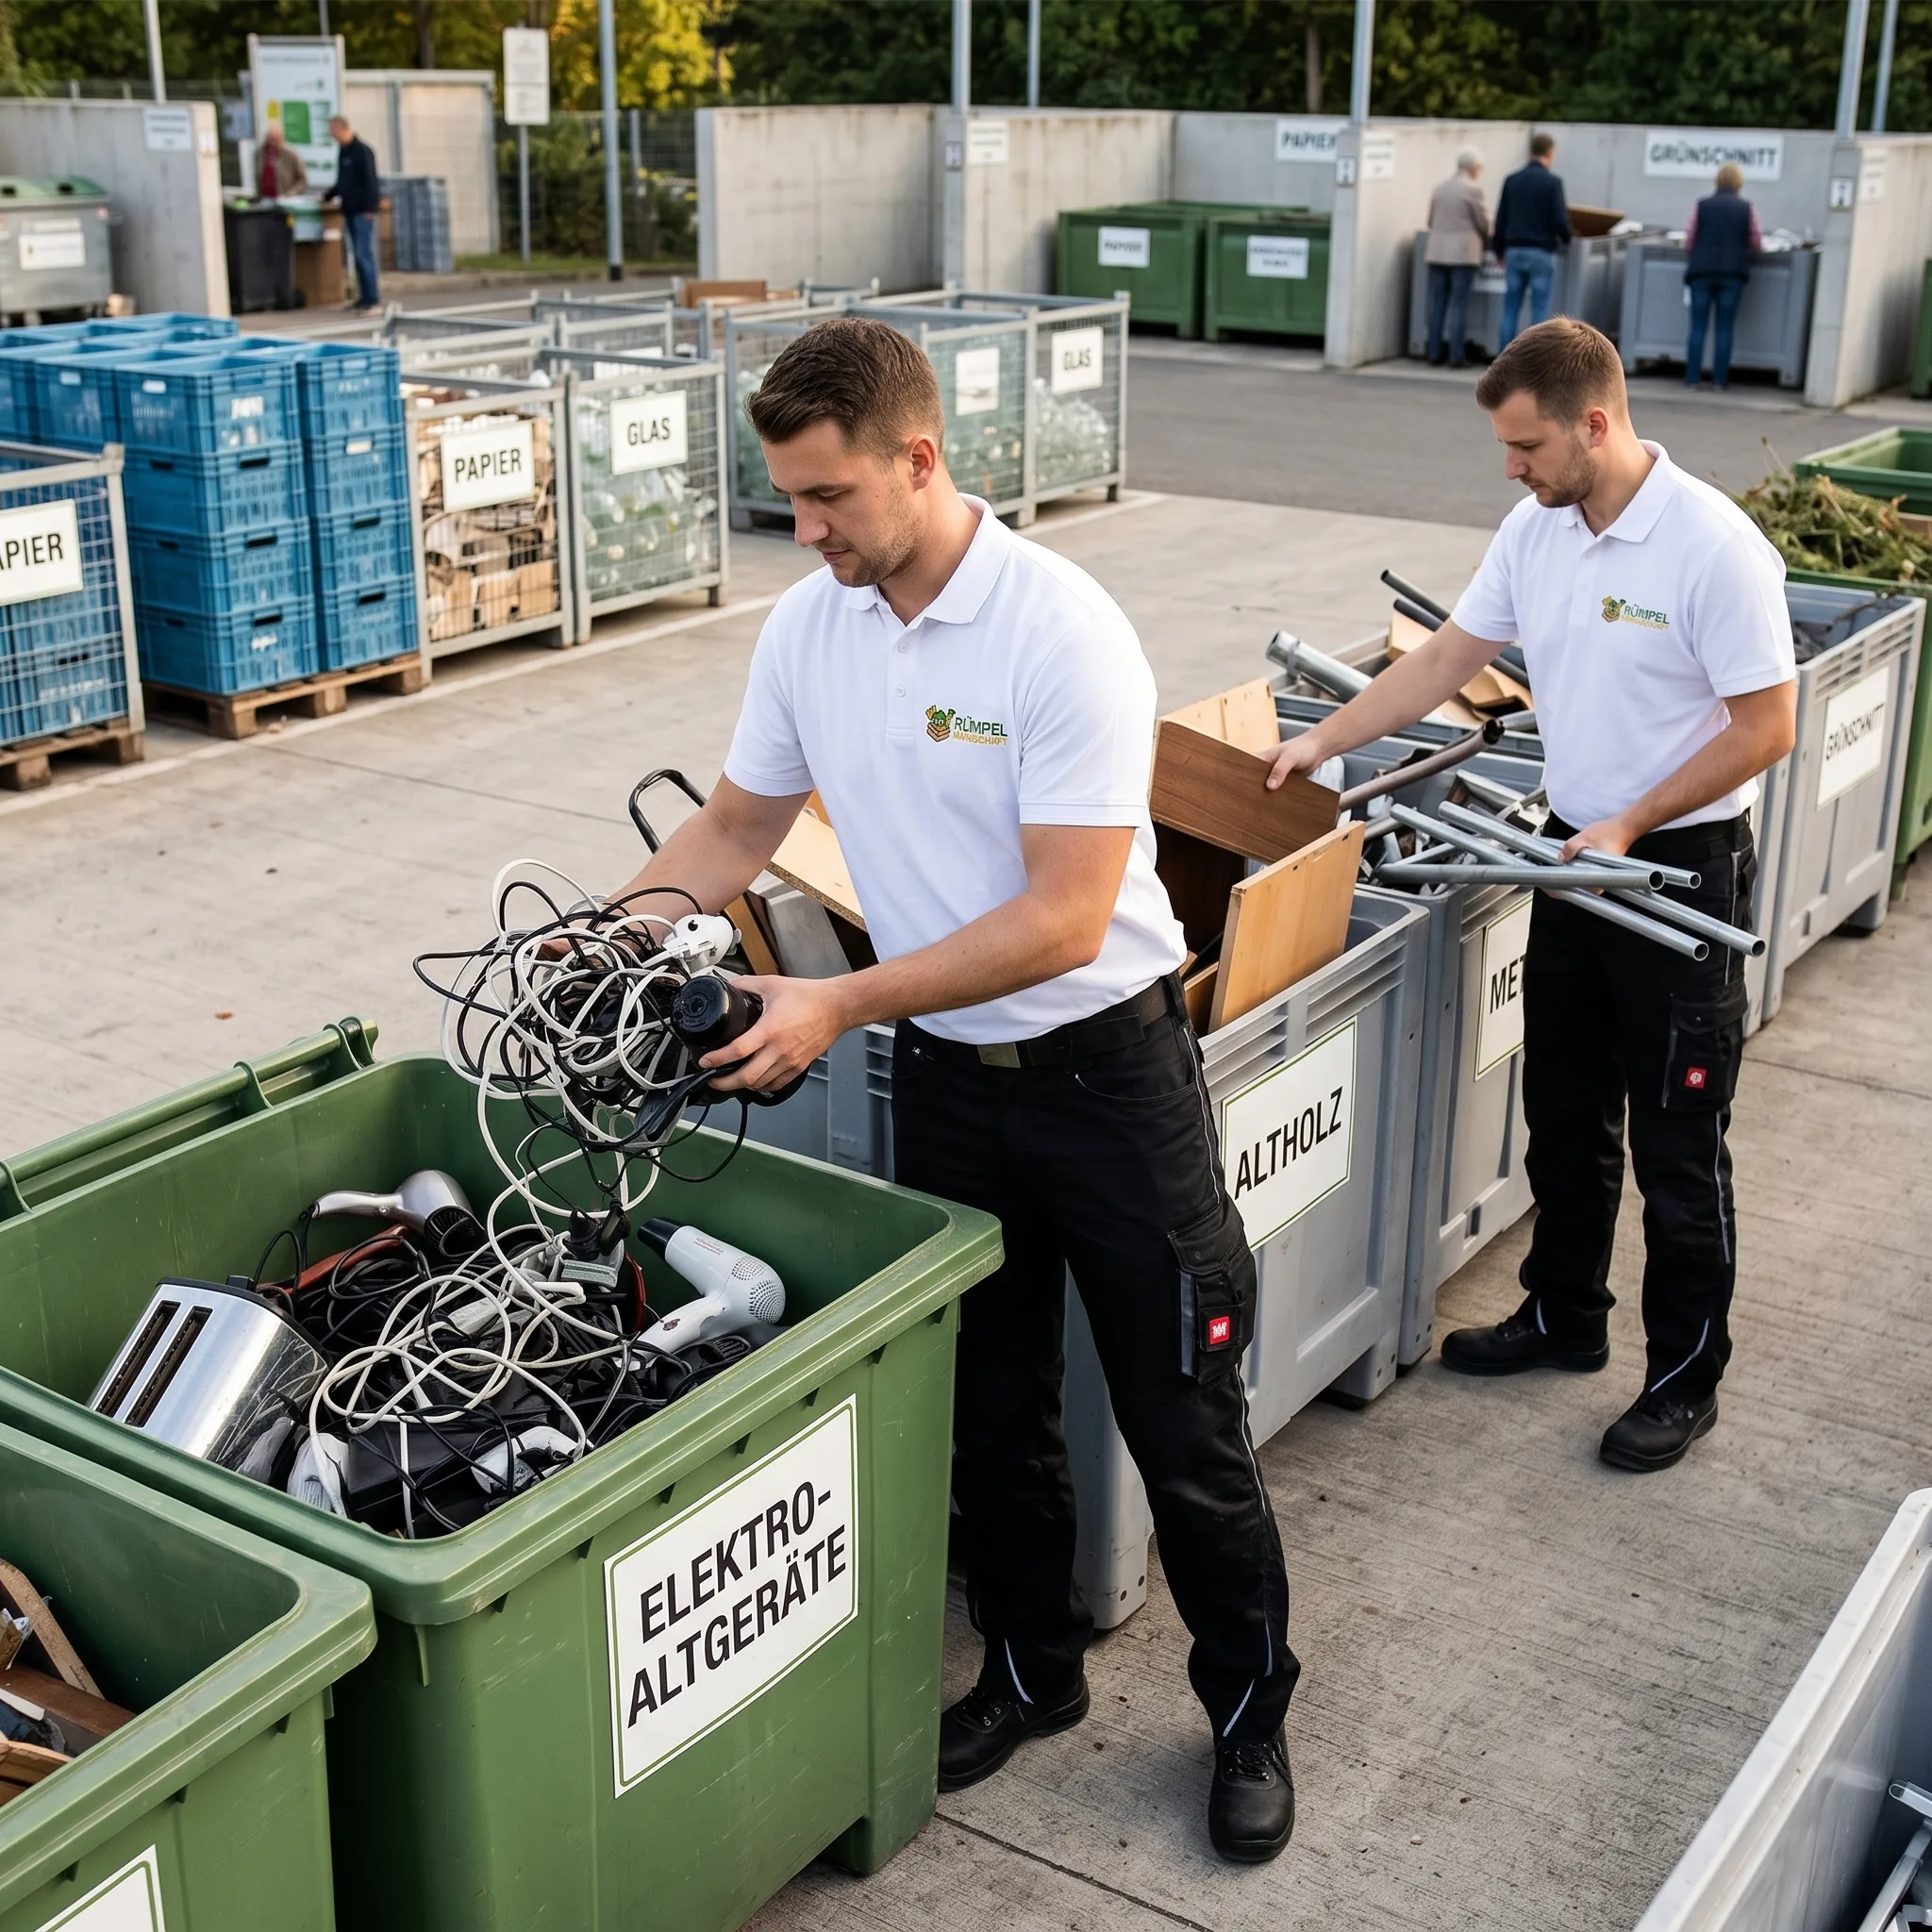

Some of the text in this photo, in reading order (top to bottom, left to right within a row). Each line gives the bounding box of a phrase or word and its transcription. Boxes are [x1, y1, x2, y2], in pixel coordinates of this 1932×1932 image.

[1650, 140, 1777, 168] GRÜNSCHNITT
[626, 417, 671, 447] GLAS
[455, 448, 523, 483] PAPIER
[0, 532, 63, 571] PIER
[1624, 603, 1670, 625] RÜMPEL
[954, 715, 1008, 738] RÜMPEL
[1825, 703, 1885, 761] GRÜNSCHNITT
[1489, 953, 1525, 1015] MET
[1234, 1085, 1343, 1201] ALTHOLZ
[640, 1481, 831, 1644] ELEKTRO-
[627, 1524, 846, 1729] ALTGERÄTE
